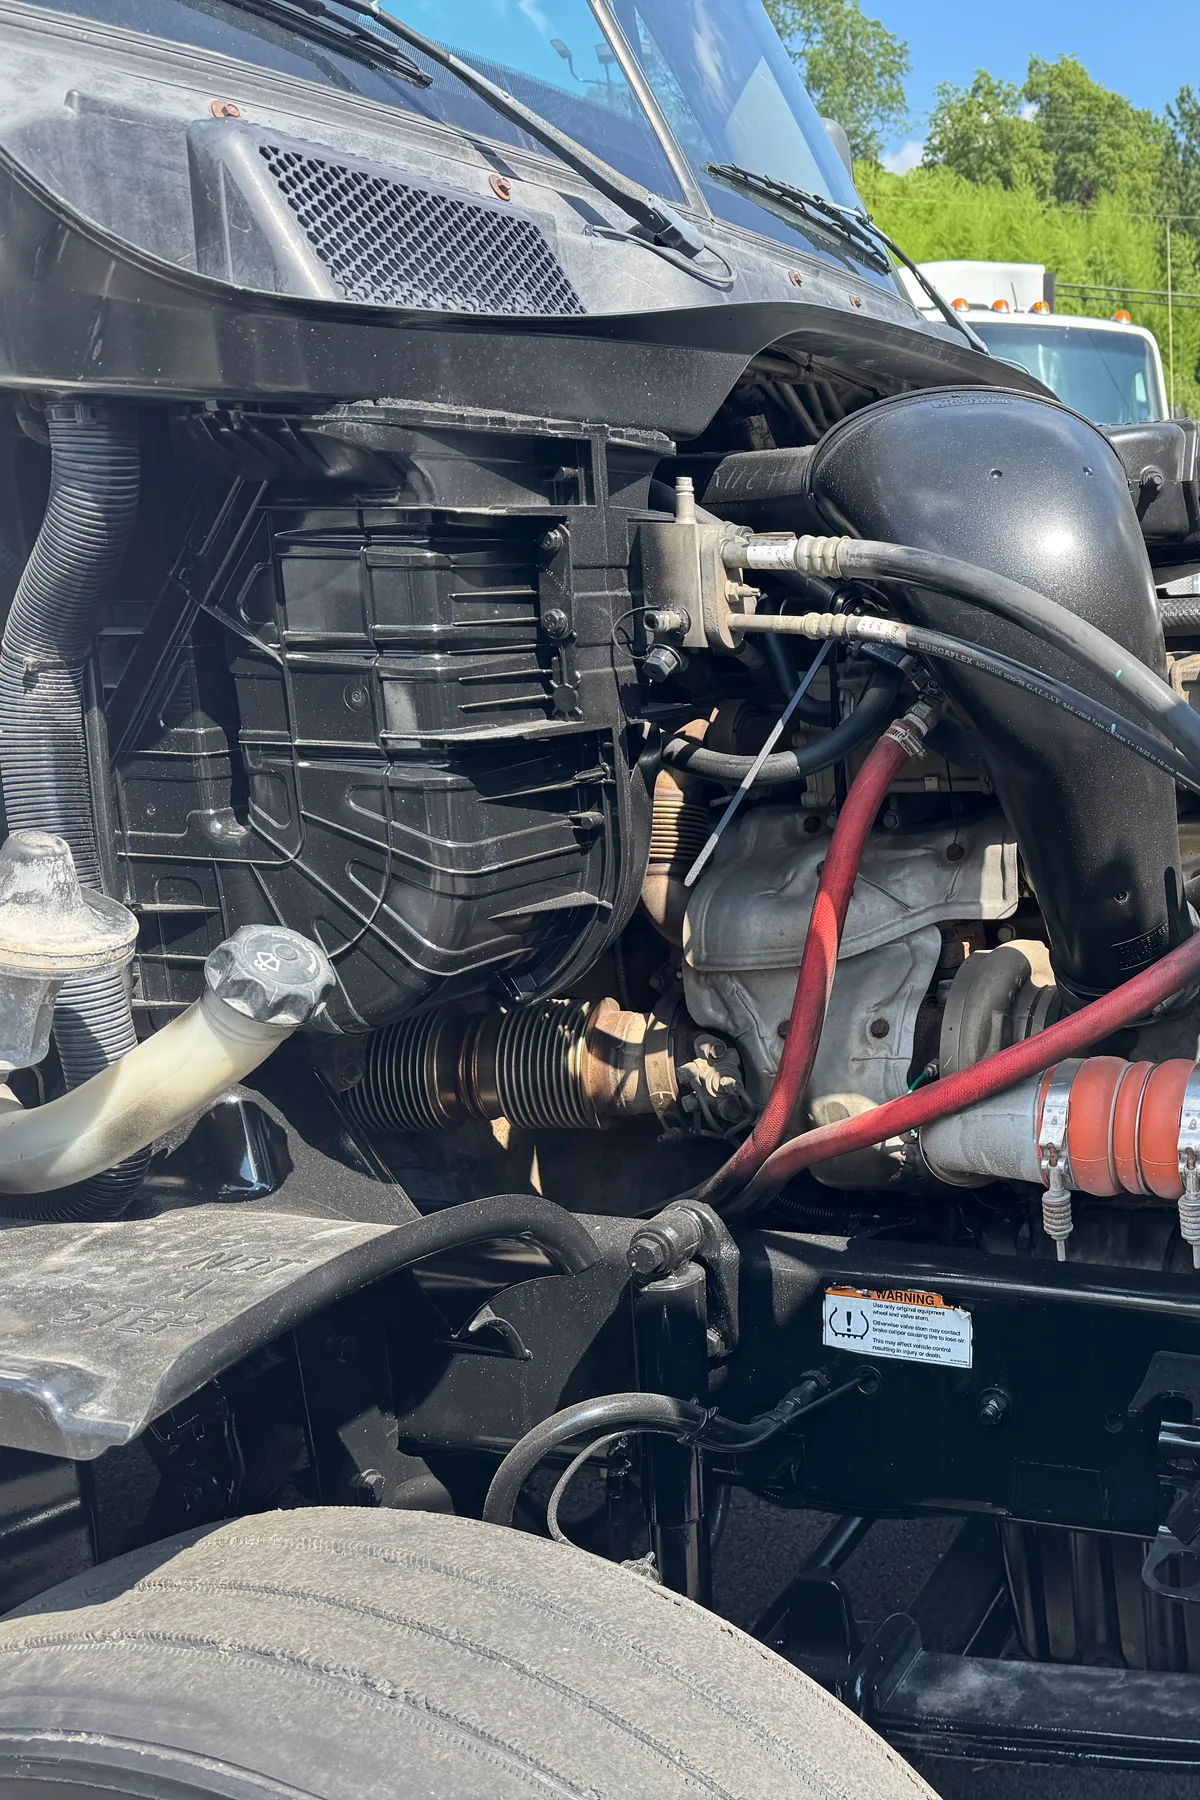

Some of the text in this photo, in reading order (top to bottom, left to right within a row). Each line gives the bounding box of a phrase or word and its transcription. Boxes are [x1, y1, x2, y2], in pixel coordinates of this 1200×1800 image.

[918, 641, 973, 665] BURGAFLEX
[986, 665, 1002, 677] HOSE
[1026, 683, 1061, 704] GALAXY
[1063, 702, 1075, 711] SAE
[1092, 717, 1105, 729] Type
[1164, 764, 1175, 773] mm
[182, 1252, 308, 1278] NOT
[876, 1290, 935, 1306] WARNING
[51, 1302, 208, 1336] STEP
[916, 1308, 945, 1317] equipment
[873, 1320, 899, 1329] Otherwise
[941, 1329, 961, 1337] contact
[907, 1331, 928, 1340] causing
[873, 1345, 895, 1353] resulting
[903, 1348, 918, 1357] injury
[926, 1351, 941, 1359] death.
[897, 1340, 912, 1348] affect
